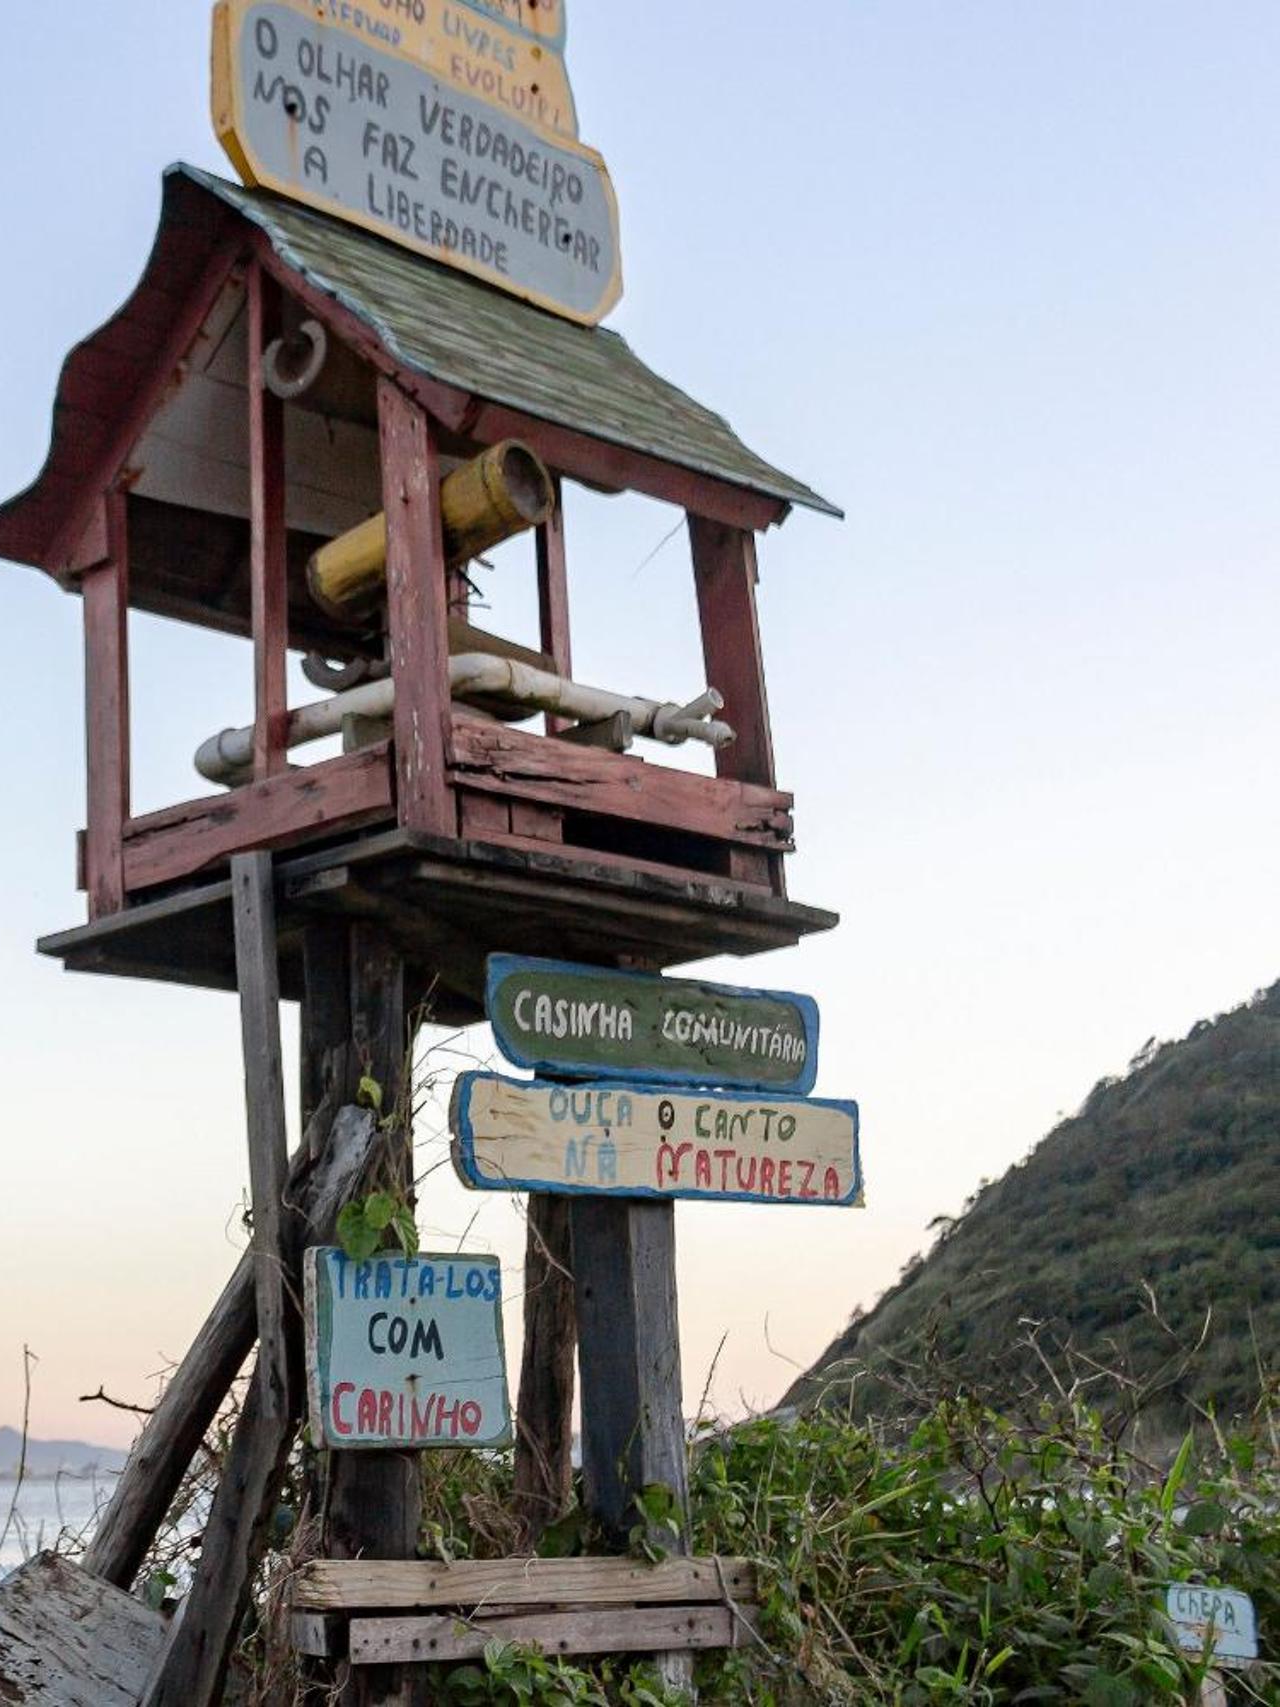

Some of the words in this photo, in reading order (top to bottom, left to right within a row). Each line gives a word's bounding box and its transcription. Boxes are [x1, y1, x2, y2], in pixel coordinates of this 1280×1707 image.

[253, 71, 332, 135] NOS
[362, 120, 419, 181] FAZ
[255, 18, 278, 59] O
[297, 38, 391, 109] OLHAR
[419, 94, 583, 208] VERDADEIRO
[303, 144, 329, 183] A
[367, 172, 510, 275] LIBERDADE
[514, 988, 633, 1042] CASINHA
[658, 1100, 676, 1131] O
[694, 1104, 797, 1143] CANTO
[656, 1141, 841, 1200] NATUREZA
[331, 1250, 500, 1301] TRATA-LOS
[368, 1311, 445, 1360] COM
[332, 1382, 482, 1438] CARINHO
